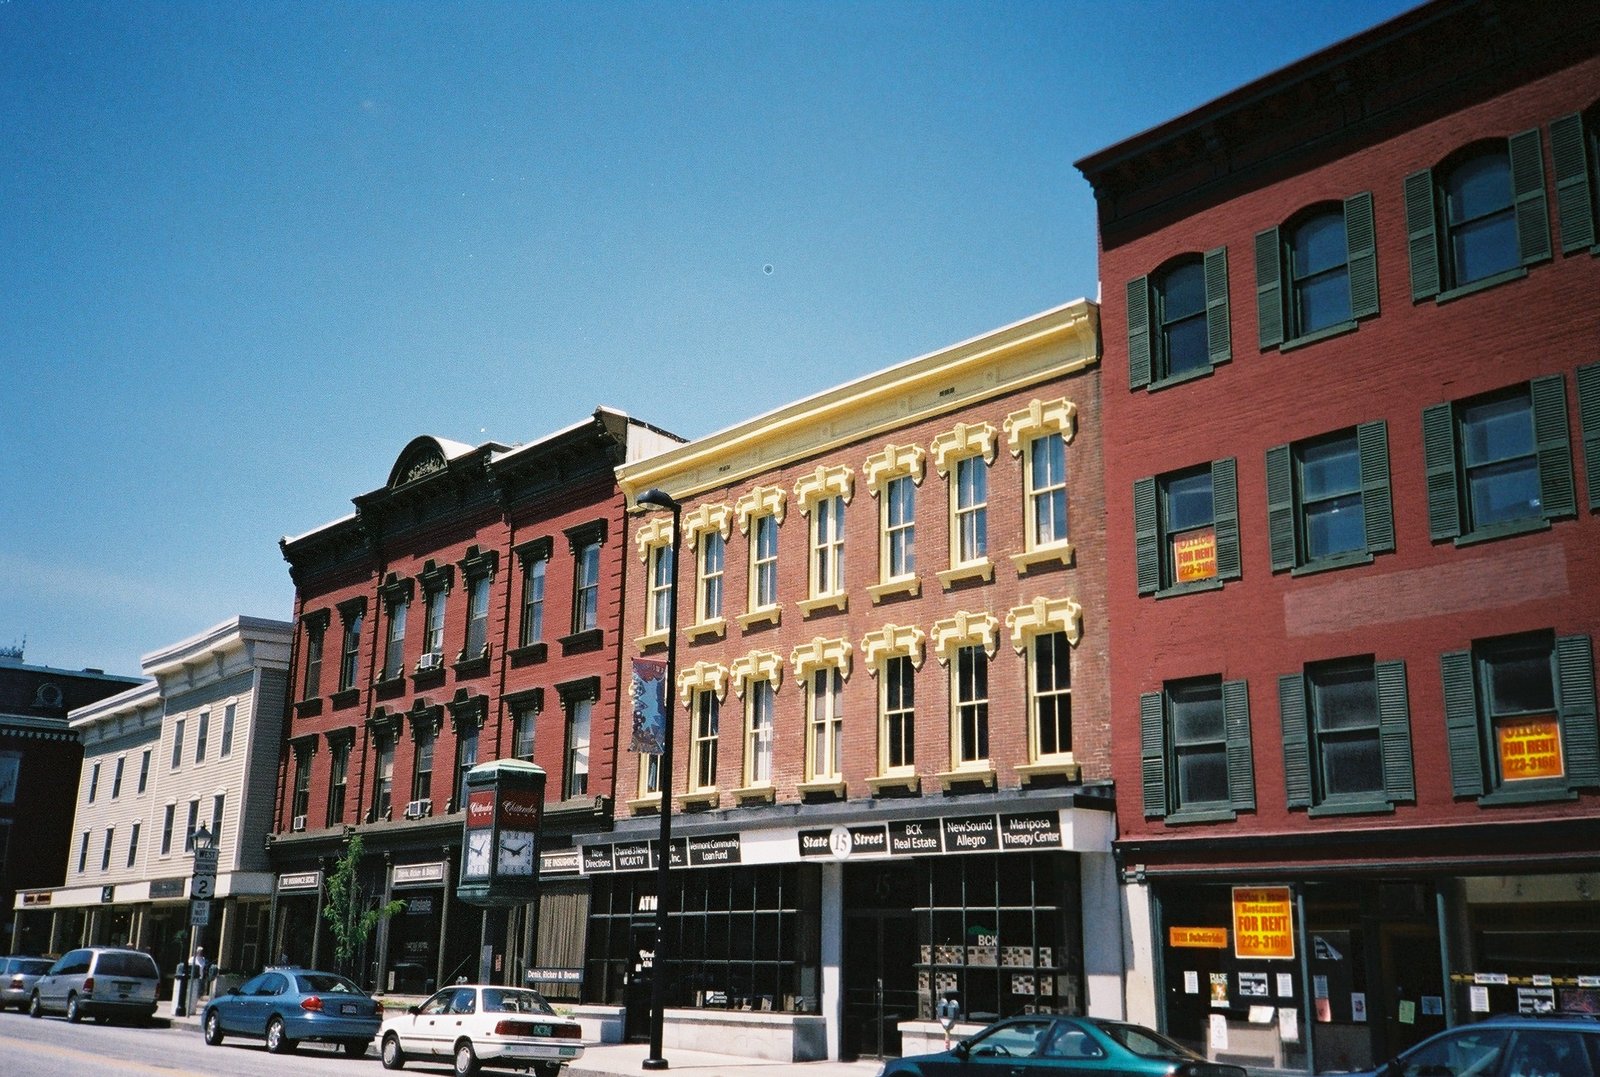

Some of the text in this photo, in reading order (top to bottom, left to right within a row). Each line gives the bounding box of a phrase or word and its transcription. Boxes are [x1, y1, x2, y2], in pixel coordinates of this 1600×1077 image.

[1178, 546, 1214, 563] FOR RENT
[1503, 738, 1555, 757] FOR RENT
[905, 824, 923, 836] BCK
[1010, 819, 1051, 832] Mariposa
[689, 838, 740, 850] Vermont Community
[803, 832, 884, 852] State 15 Street
[894, 837, 937, 850] Real Estate
[956, 834, 987, 848] Allegro
[1003, 831, 1060, 845] Therapy Center
[199, 851, 216, 859] WEST
[702, 850, 728, 861] Loan Fund
[585, 858, 611, 868] Directions
[198, 880, 209, 894] 2
[1239, 915, 1288, 932] FOR RENT
[978, 934, 998, 946] BCK
[1241, 934, 1288, 949] 223-3166
